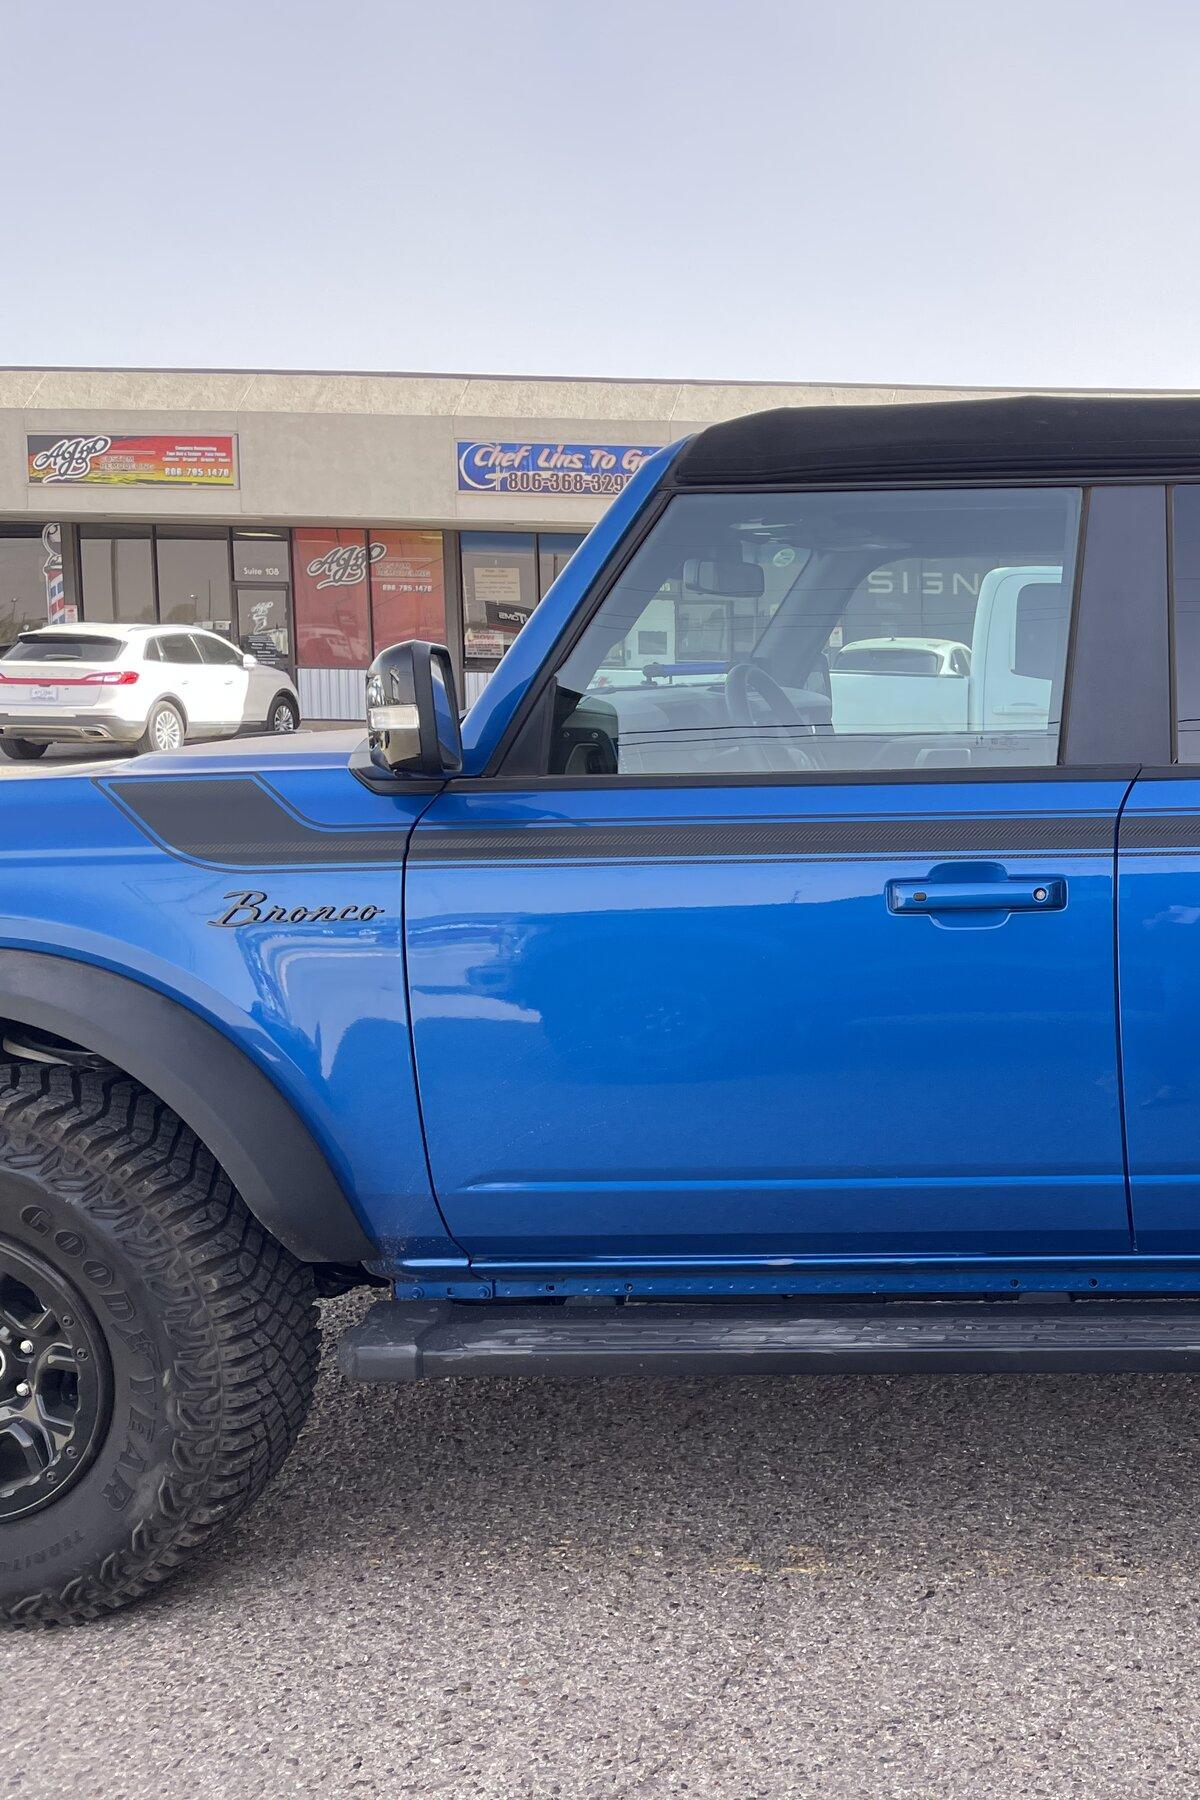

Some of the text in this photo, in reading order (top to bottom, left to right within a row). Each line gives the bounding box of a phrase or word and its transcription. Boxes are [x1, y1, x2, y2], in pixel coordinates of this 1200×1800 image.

[473, 445, 532, 468] Chef
[590, 448, 617, 468] To
[243, 567, 280, 576] Suite 108
[207, 890, 385, 928] Bronco
